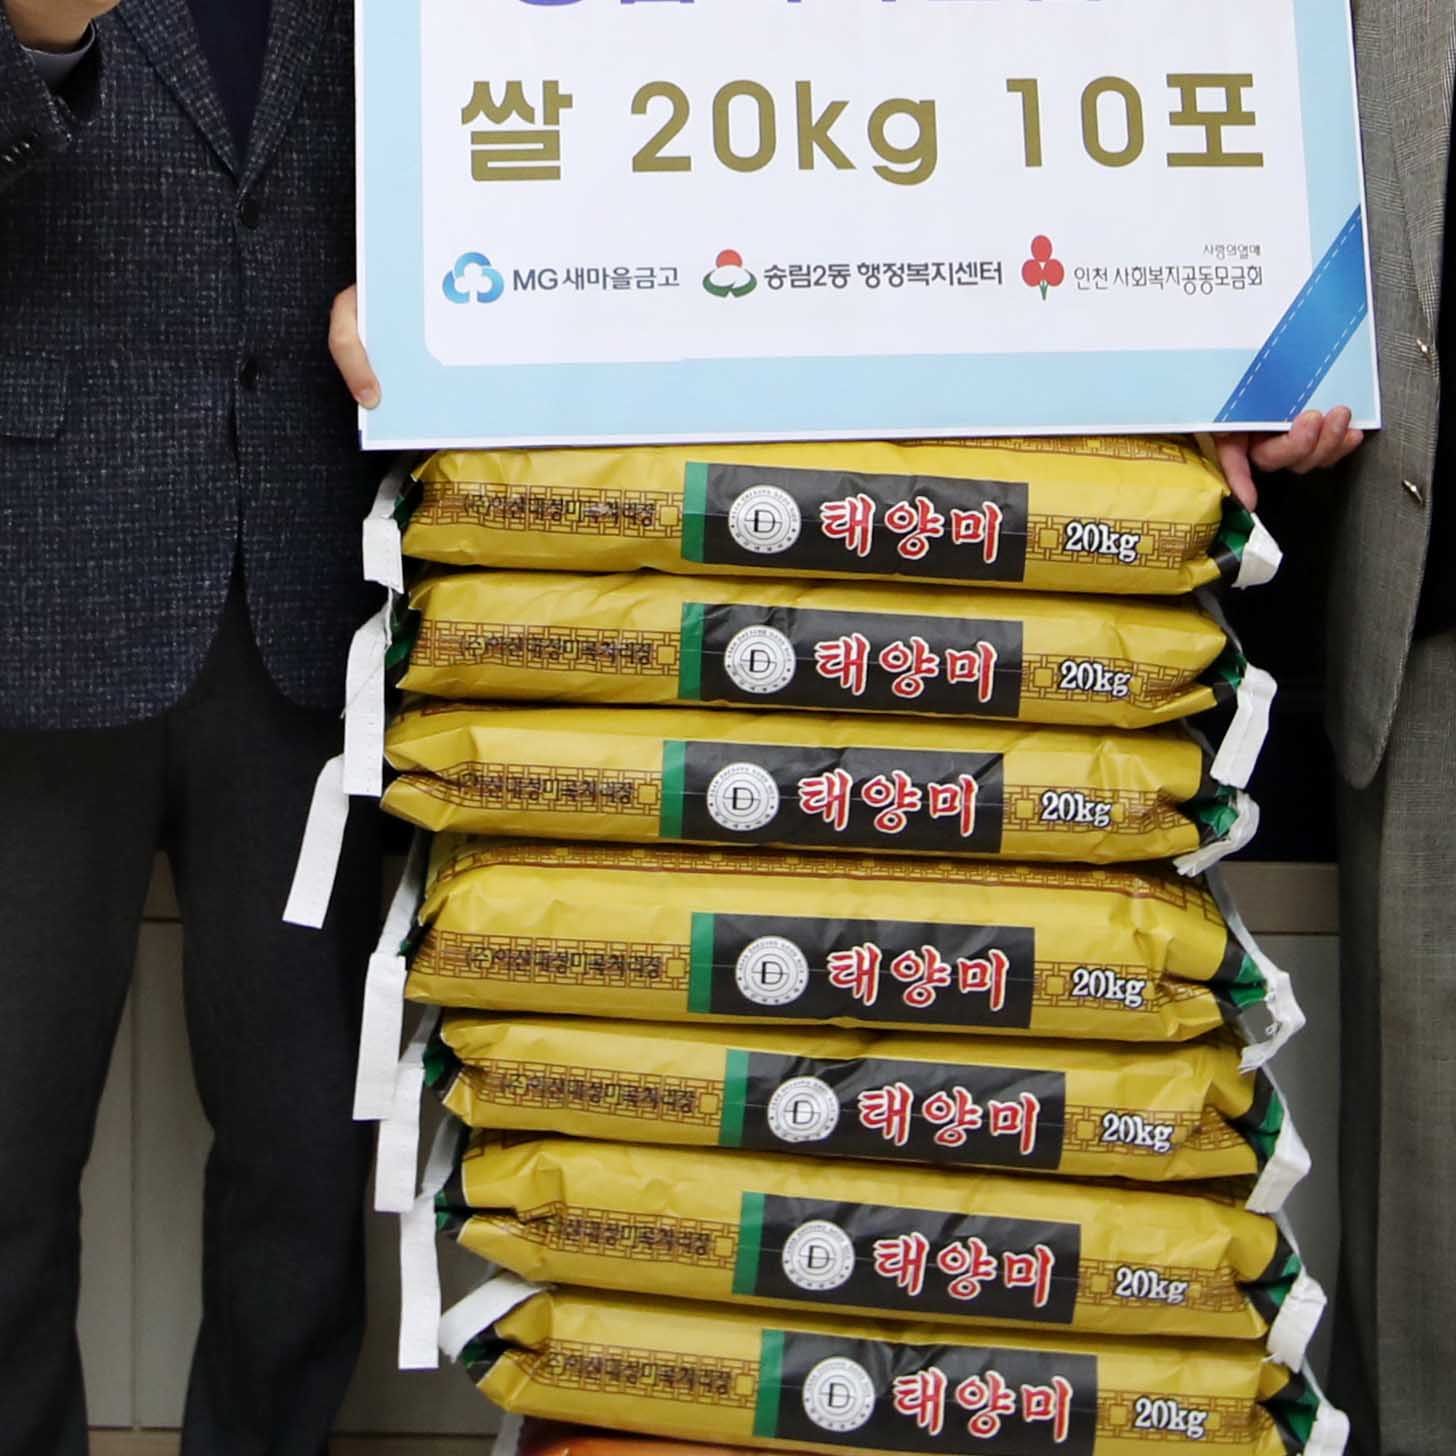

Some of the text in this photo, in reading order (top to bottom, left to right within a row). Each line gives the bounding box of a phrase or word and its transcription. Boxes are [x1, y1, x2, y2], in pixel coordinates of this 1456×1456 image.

[460, 72, 1266, 187] 쌀 20kg 10포
[512, 266, 680, 292] MG 새마을금고
[764, 261, 1003, 289] 송림2동 행정복지센터
[1074, 264, 1263, 296] 인천 사회복지공동모금회
[818, 492, 1002, 564] 태양미
[1064, 519, 1141, 564] 20kg
[813, 630, 1134, 704] 태양미 20kg
[796, 768, 1114, 836] 태양미 20kg
[825, 943, 1146, 1012] 태양미 20kg
[857, 1085, 1174, 1156] 태양미 20kg
[873, 1232, 1189, 1306] 태양미 20kg
[893, 1371, 1209, 1447] 태양미 20kg
